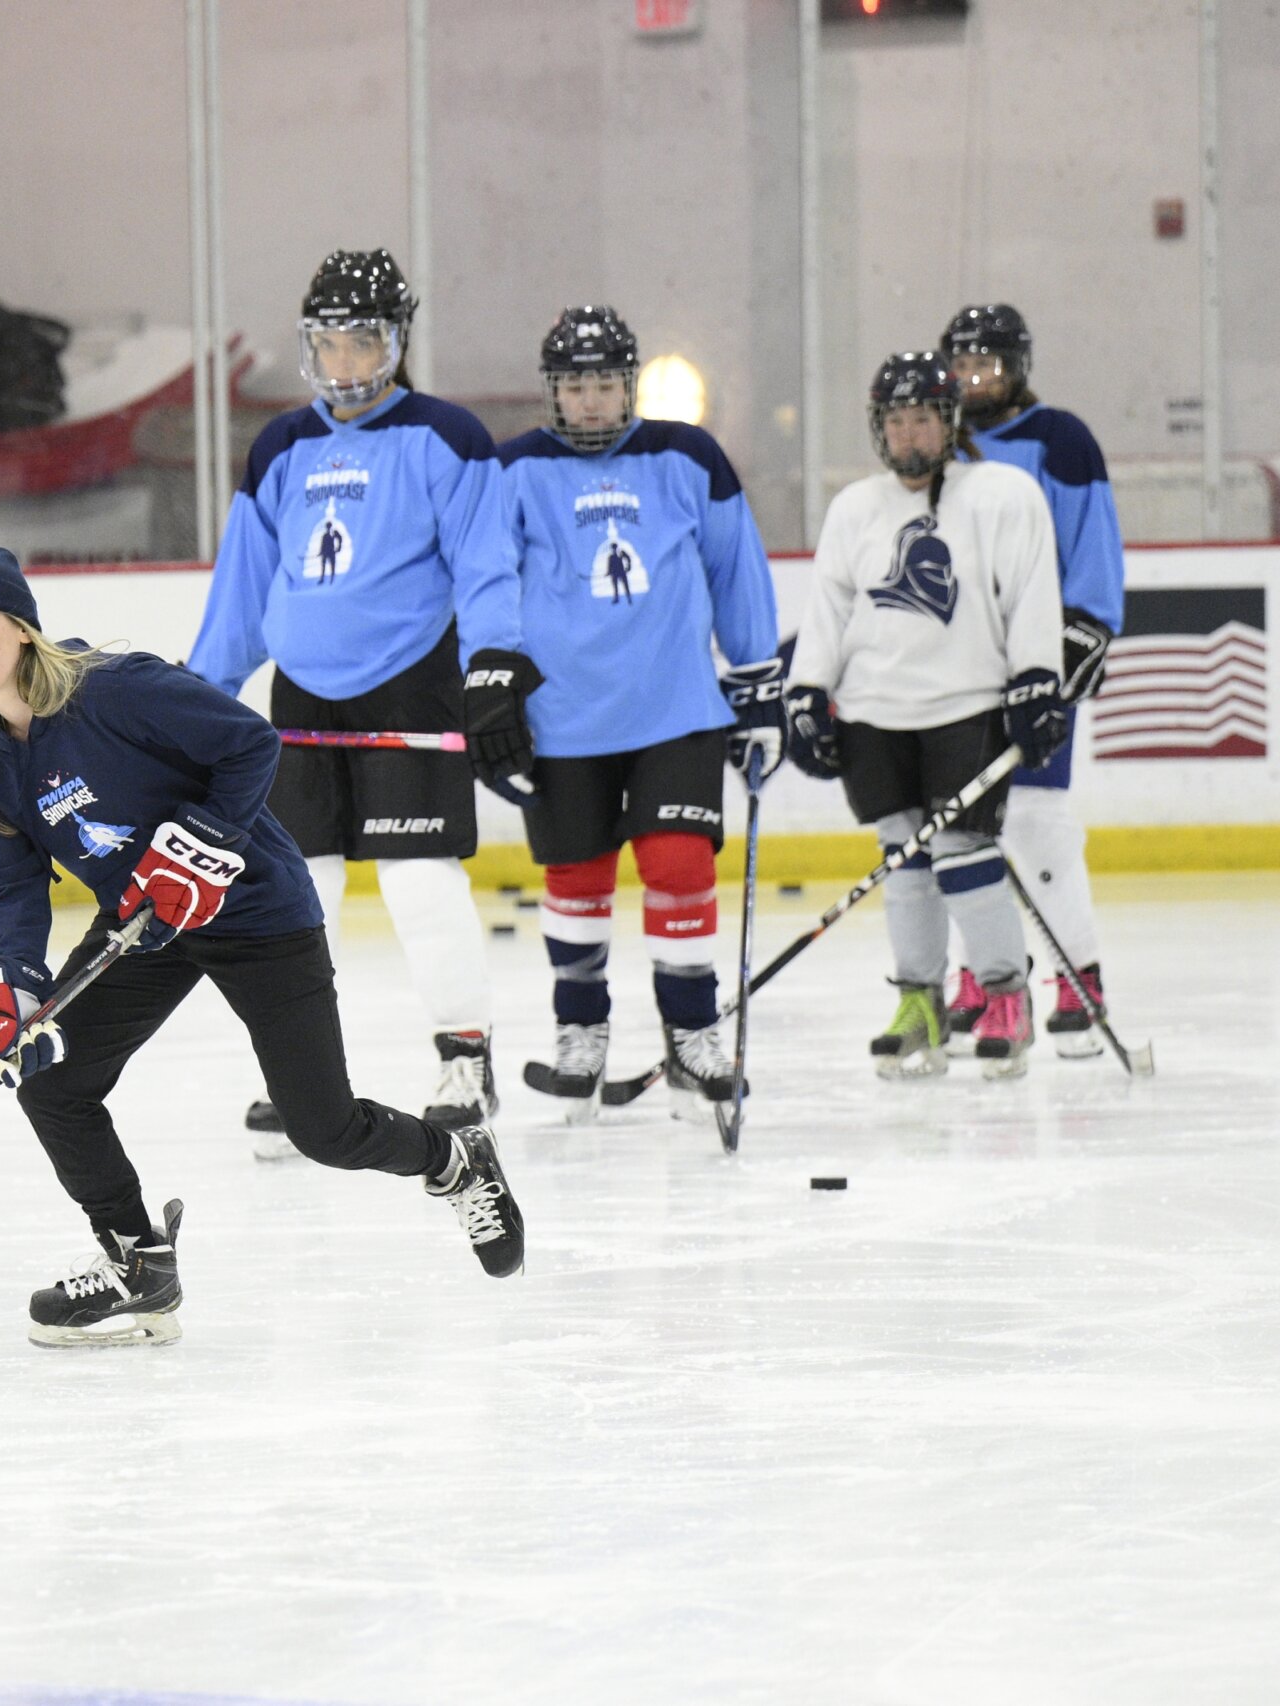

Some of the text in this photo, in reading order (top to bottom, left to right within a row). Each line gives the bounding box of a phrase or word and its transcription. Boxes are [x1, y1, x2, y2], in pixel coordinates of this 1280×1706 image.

[37, 776, 86, 812] PWHPA
[41, 786, 99, 826] SHOWCASE
[186, 815, 224, 839] STEPHENSON
[363, 818, 445, 834] BAUER
[657, 805, 721, 825] CCM
[166, 831, 241, 879] CCM
[822, 796, 964, 927] EASTON
